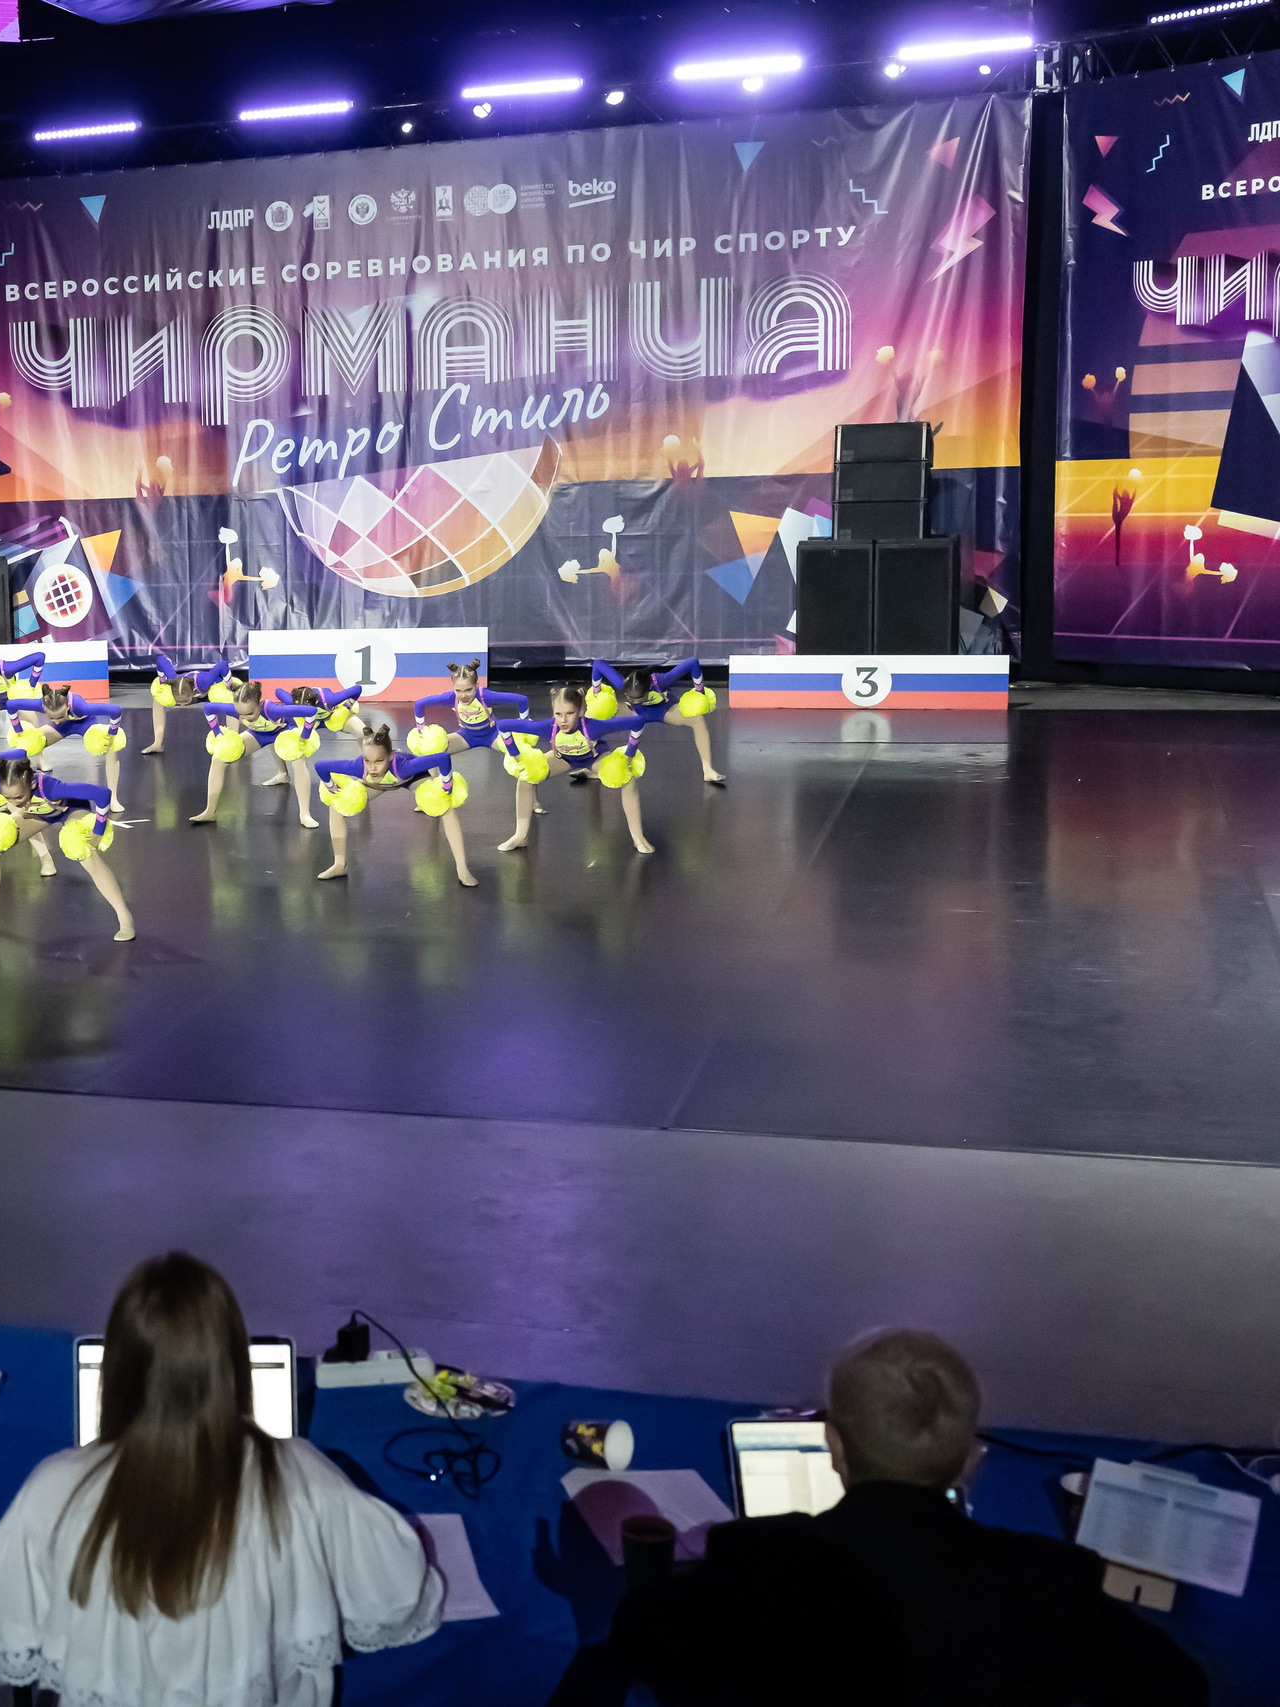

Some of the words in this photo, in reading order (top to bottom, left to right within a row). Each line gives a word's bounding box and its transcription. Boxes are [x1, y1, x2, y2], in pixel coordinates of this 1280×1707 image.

[568, 178, 617, 197] beko
[207, 208, 255, 232] ЛДПР
[4, 265, 266, 302] ВСЕРОССИЙСКИЕ
[281, 246, 549, 284] СОРЕВНОВАНИЯ
[567, 242, 612, 264] ПО
[628, 236, 698, 259] ЧИР
[714, 225, 857, 255] СПОРТУ
[1132, 249, 1280, 338] ЧИ
[232, 418, 404, 488] Ретро
[426, 382, 611, 452] Стиль
[354, 645, 377, 685] 1
[855, 667, 879, 698] 3
